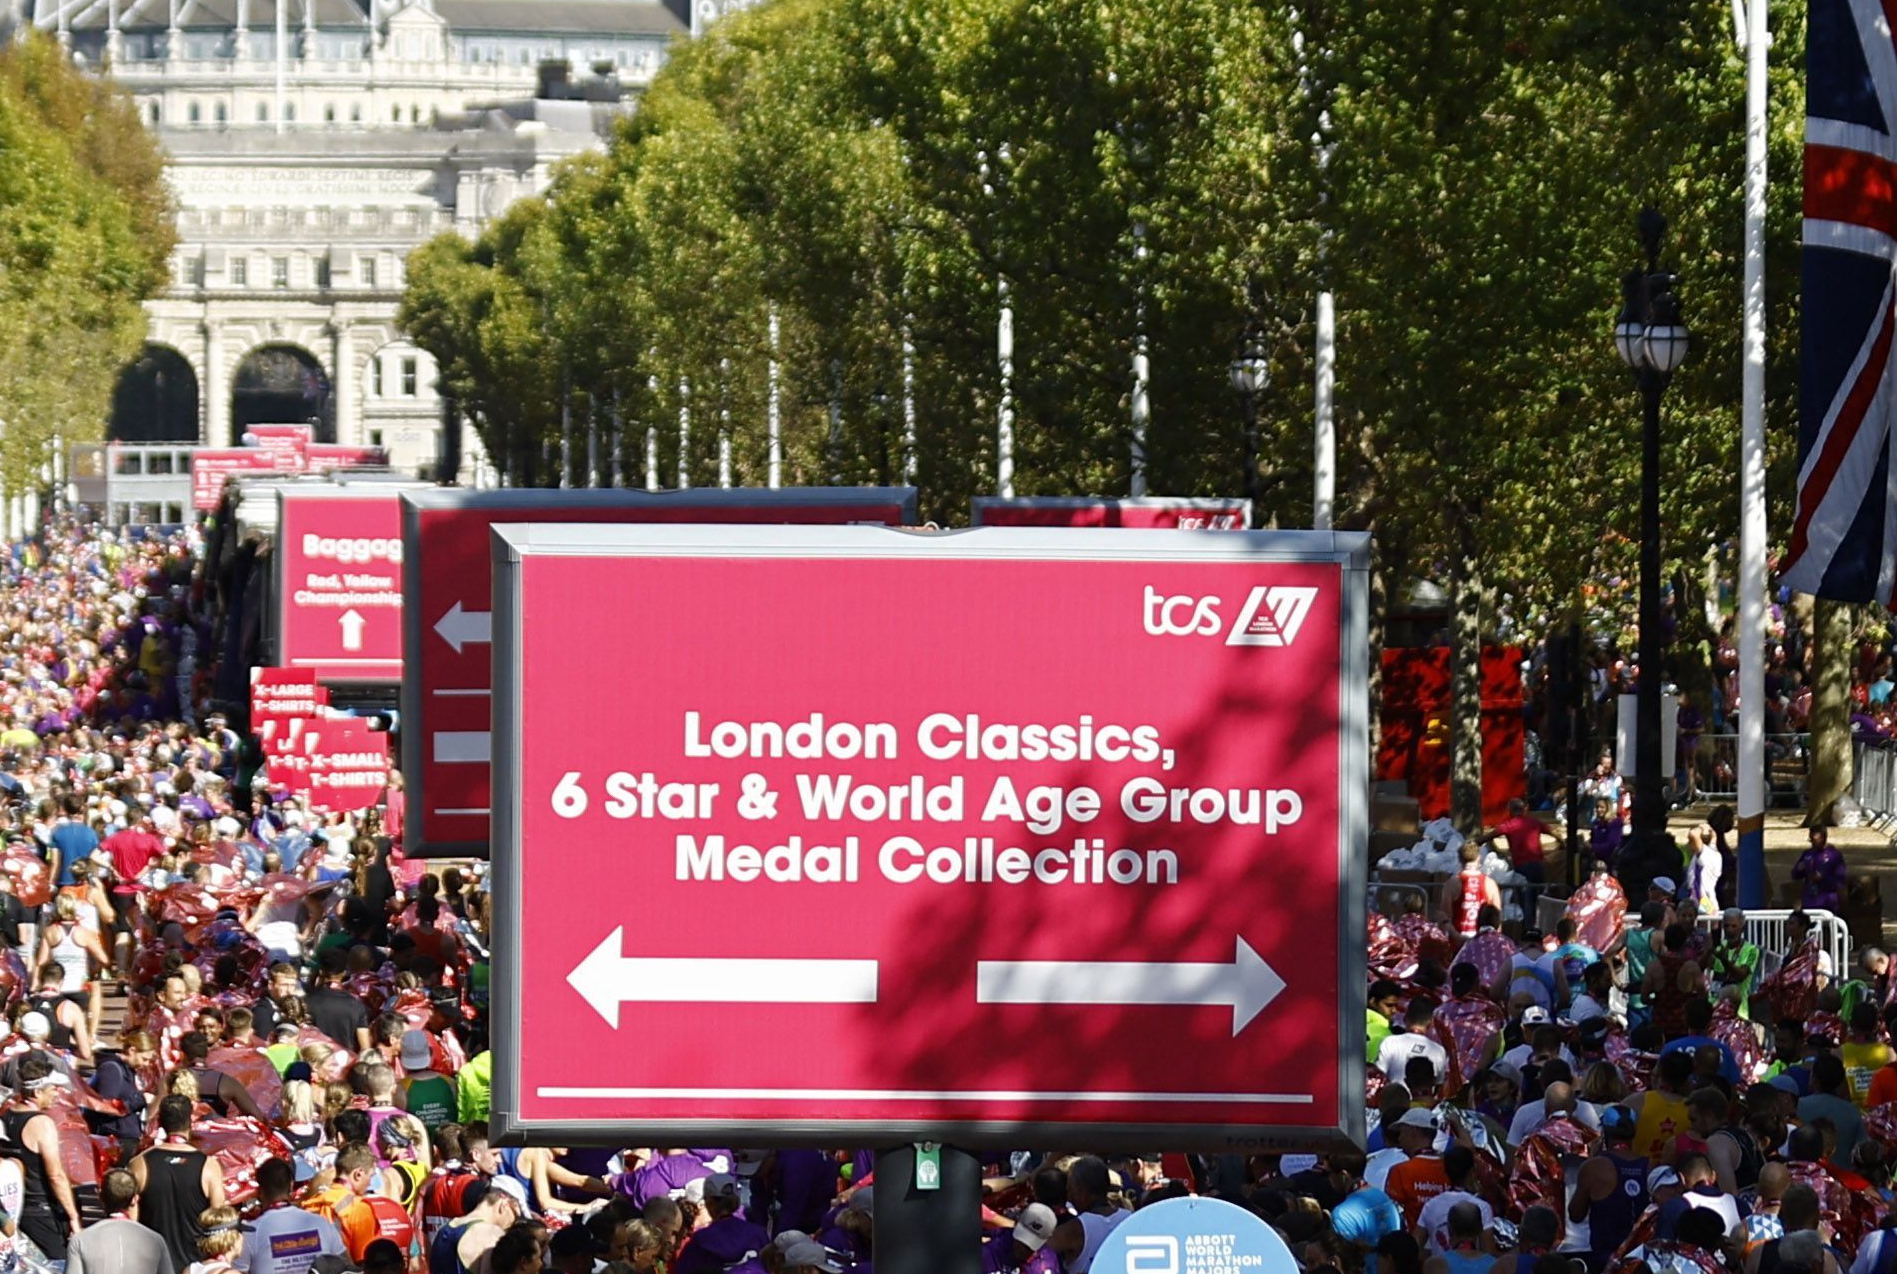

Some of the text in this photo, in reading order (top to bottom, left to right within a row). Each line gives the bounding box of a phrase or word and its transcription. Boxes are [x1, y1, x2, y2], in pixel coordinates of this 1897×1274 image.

[307, 573, 392, 589] Red, Yellow
[1143, 585, 1221, 636] tcs
[255, 684, 315, 697] X-LARGE
[253, 700, 315, 712] T-SHIRTS
[684, 712, 1175, 768] London Classics,
[310, 753, 385, 768] X-SMALL
[309, 771, 387, 786] T-SHIRTS
[552, 771, 1302, 835] 6 Star & World Age Group
[675, 834, 1178, 884] Medal Collection
[1185, 1235, 1236, 1246] ABBOTT
[1185, 1245, 1233, 1255] WORLD
[1185, 1256, 1262, 1267] MARATHON
